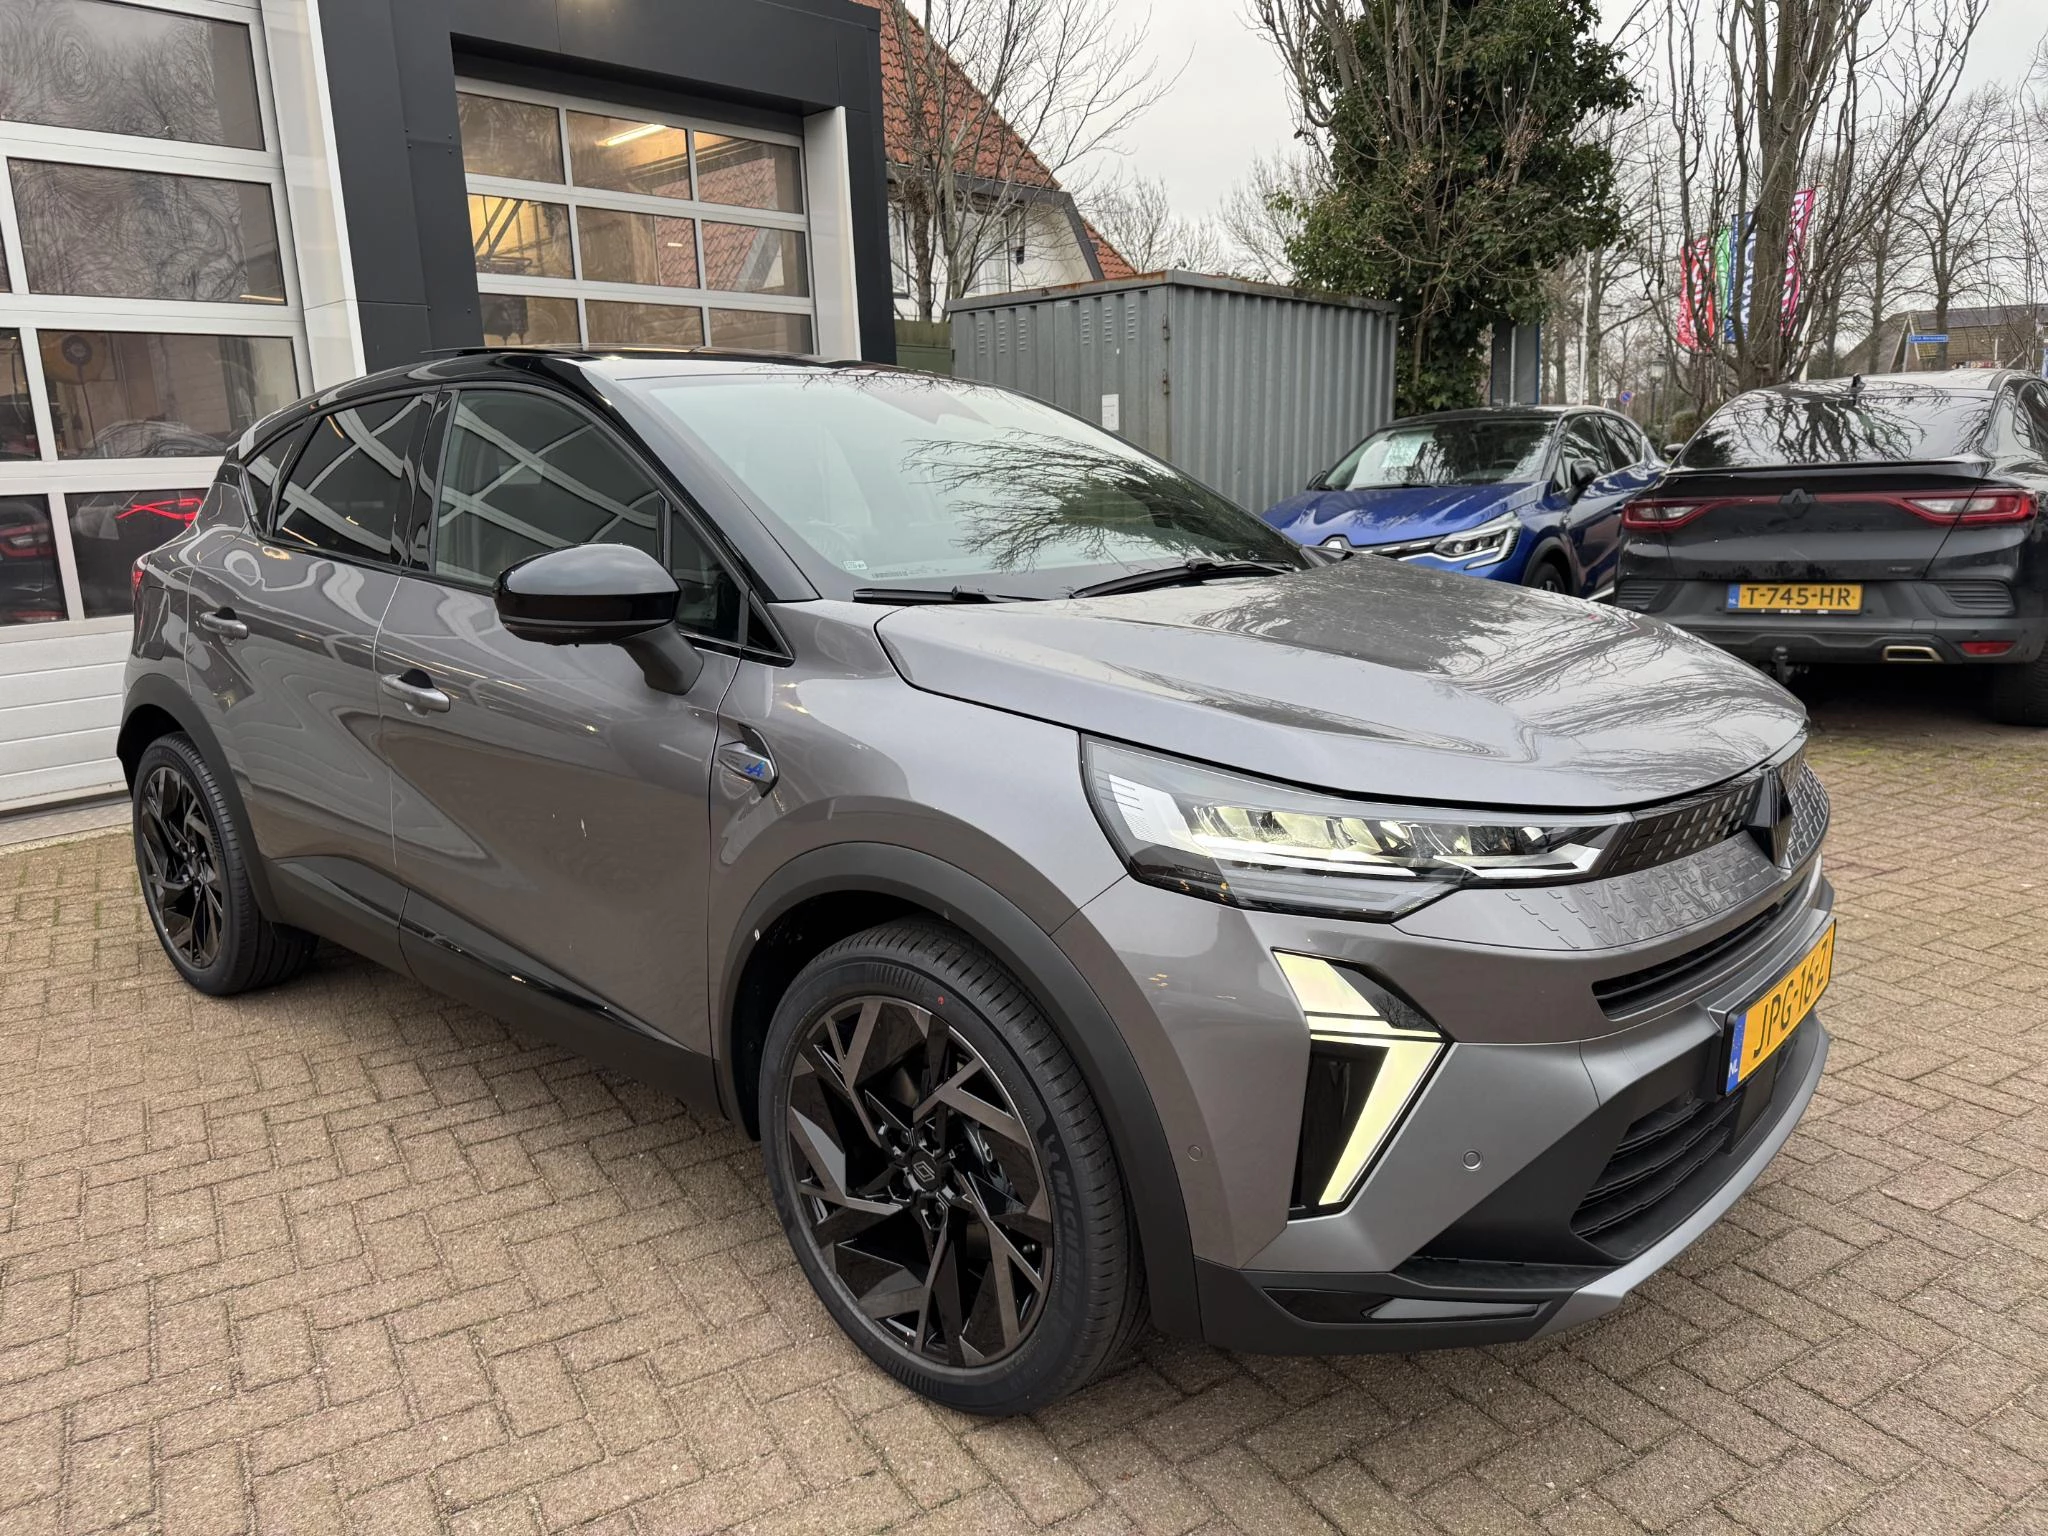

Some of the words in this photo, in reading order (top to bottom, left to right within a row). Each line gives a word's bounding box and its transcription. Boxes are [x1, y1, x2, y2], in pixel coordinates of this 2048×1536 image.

[1747, 587, 1850, 606] T-745-HR
[1753, 941, 1828, 1059] JPG-16-Z
[1729, 1061, 1738, 1077] NL
